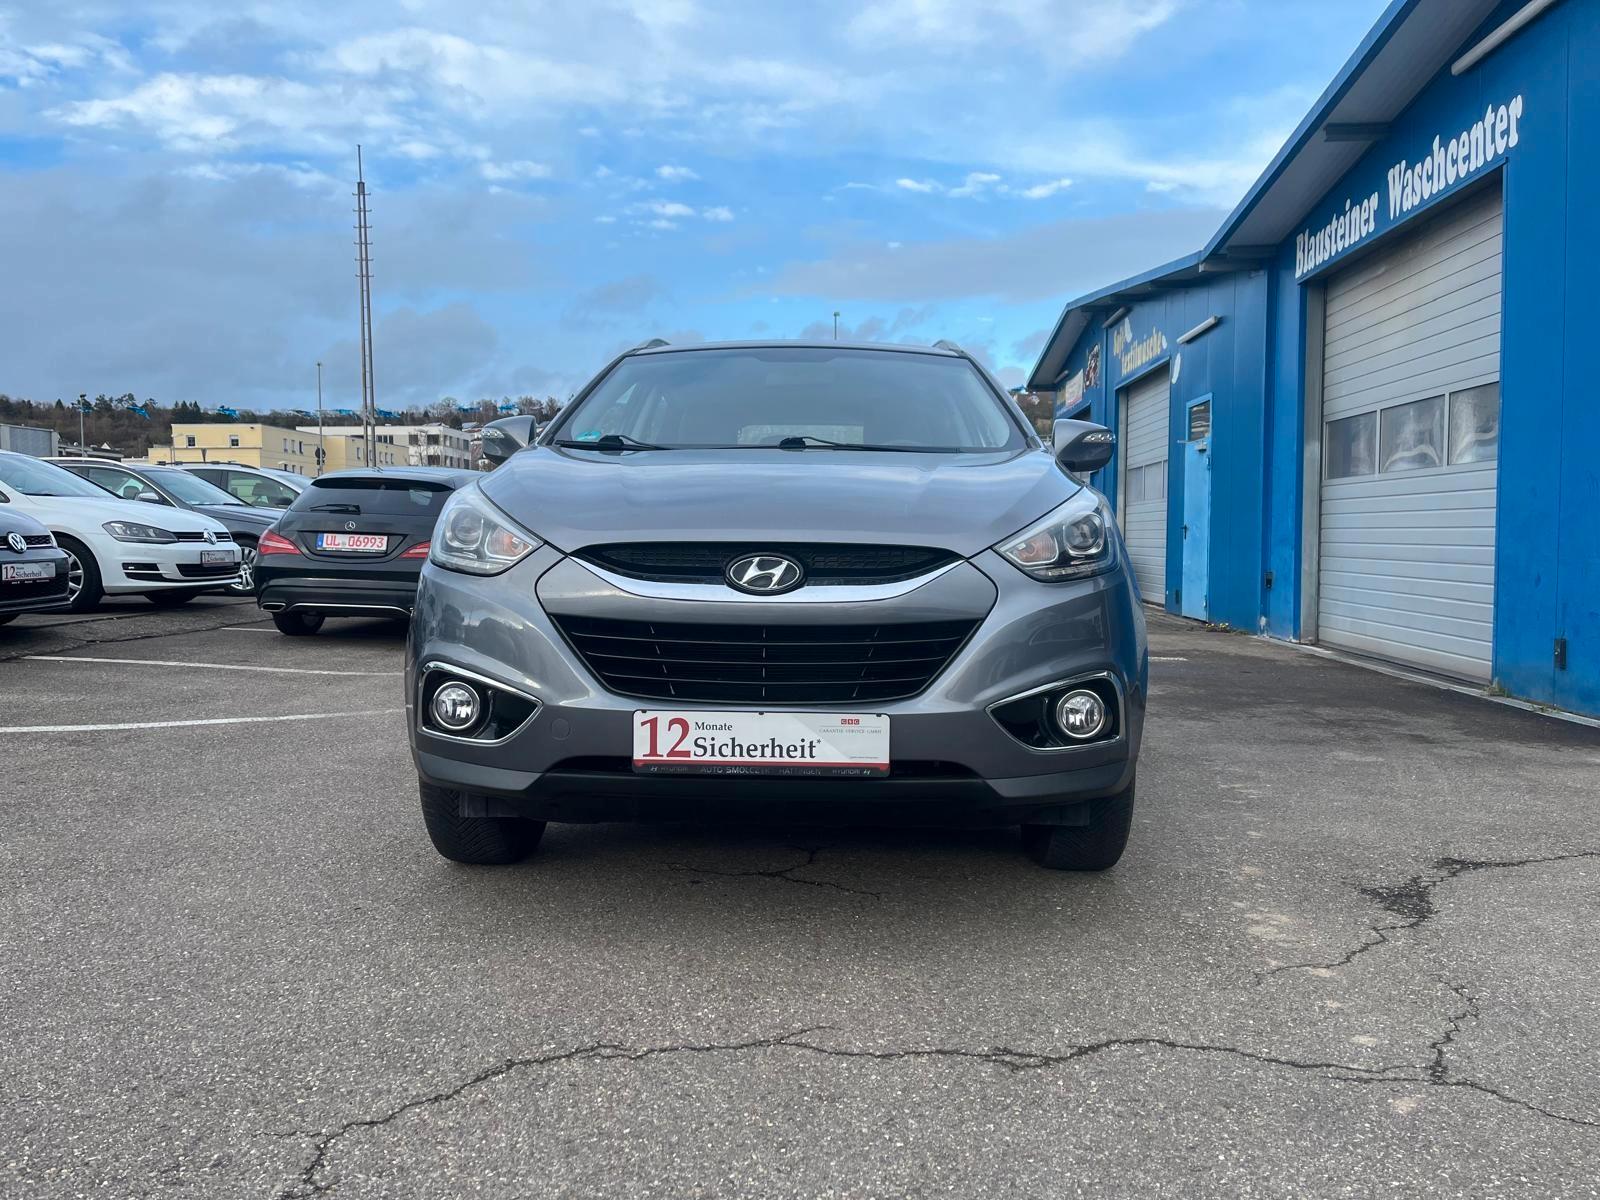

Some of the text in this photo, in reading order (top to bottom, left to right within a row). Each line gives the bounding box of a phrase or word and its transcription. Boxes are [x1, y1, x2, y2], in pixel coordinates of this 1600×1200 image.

[1295, 94, 1523, 279] Blausteiner Waschcenter
[326, 535, 385, 548] UL 06993
[4, 566, 16, 579] 12
[694, 721, 733, 732] Monate
[640, 716, 691, 759] 12
